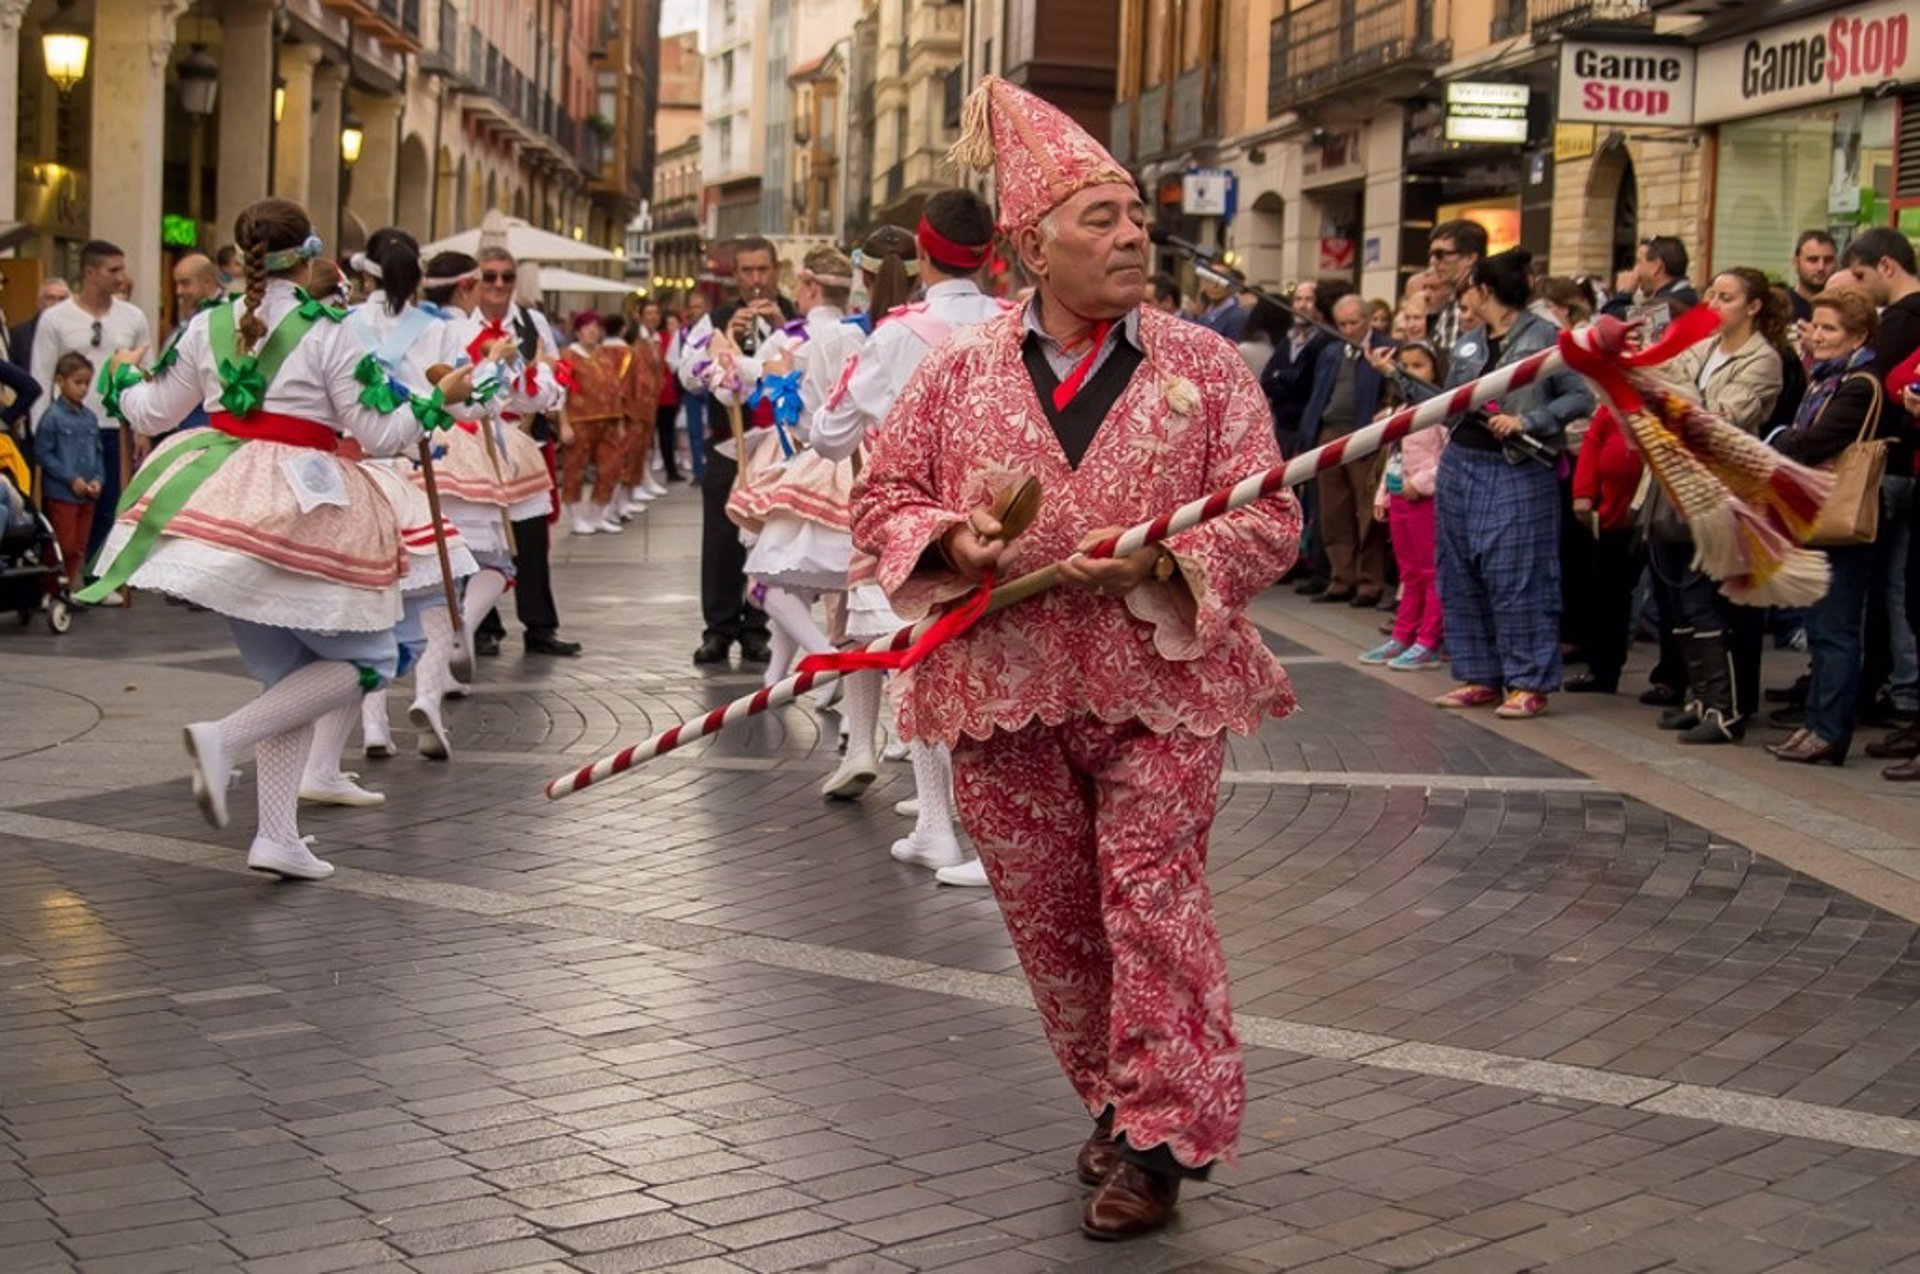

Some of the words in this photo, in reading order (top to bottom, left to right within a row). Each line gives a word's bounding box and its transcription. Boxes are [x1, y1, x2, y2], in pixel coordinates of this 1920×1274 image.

[1575, 49, 1681, 82] Game
[1742, 13, 1908, 99] GameStop
[1583, 81, 1669, 116] Stop
